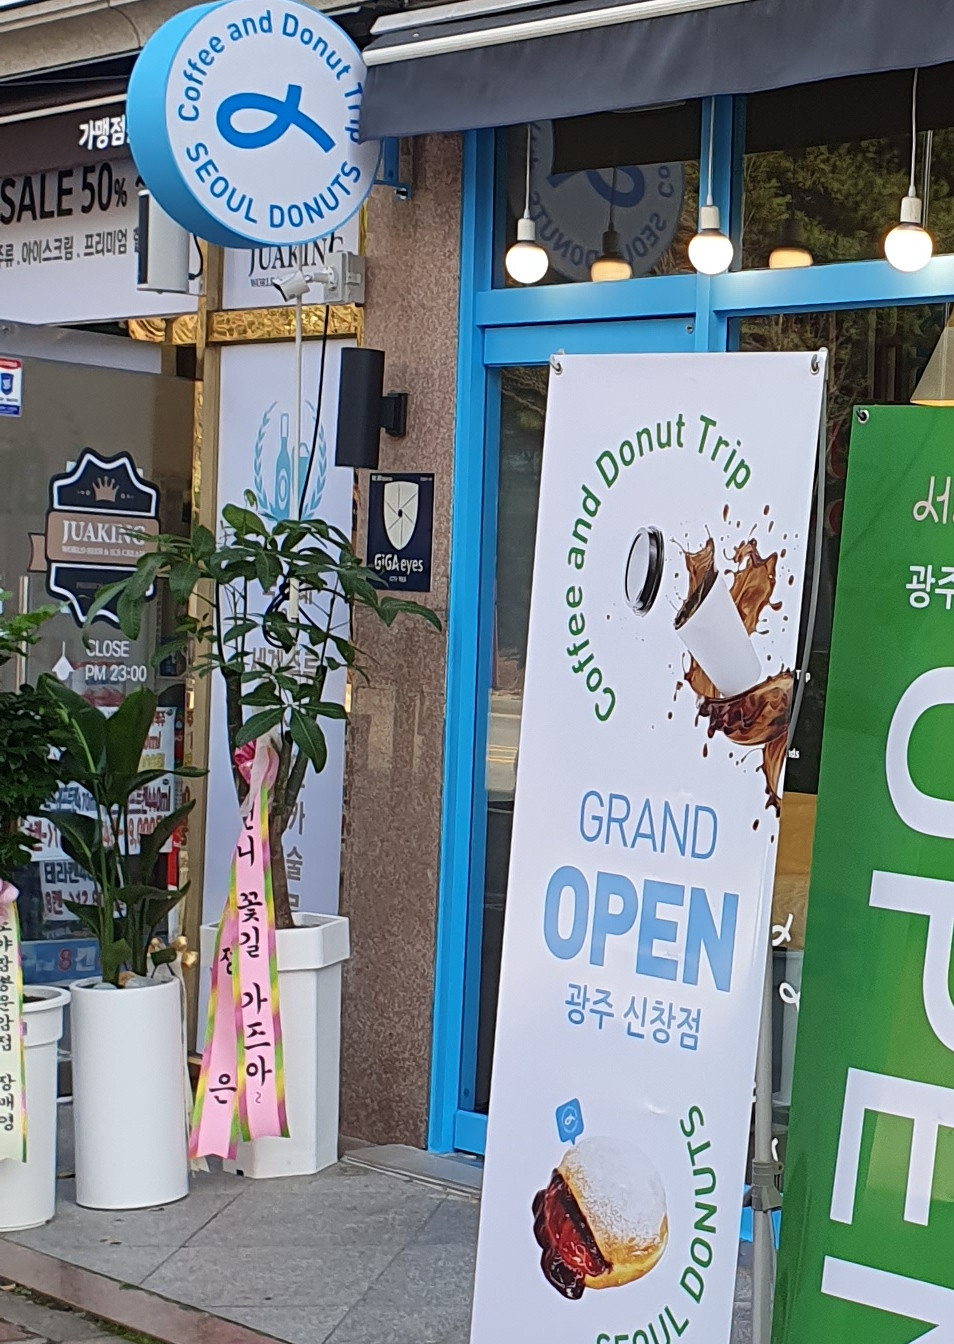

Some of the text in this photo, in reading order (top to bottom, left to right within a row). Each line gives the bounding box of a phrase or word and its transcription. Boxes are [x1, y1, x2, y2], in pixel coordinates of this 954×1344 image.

[178, 35, 225, 122] Coffee
[227, 10, 273, 41] and
[281, 11, 352, 81] Donut
[78, 114, 130, 151] 가맹점
[0, 161, 127, 225] SALE 50%
[186, 142, 362, 229] SEOUL DONUTS
[83, 228, 128, 257] 프리미엄
[565, 413, 752, 722] Coffee and Donut Trip
[85, 640, 130, 658] CLOSE
[85, 664, 147, 682] PM 23:00
[579, 790, 718, 860] GRAND
[543, 865, 740, 994] OPEN
[565, 983, 702, 1051] 광주 신창점
[679, 1104, 718, 1304] DONUTS
